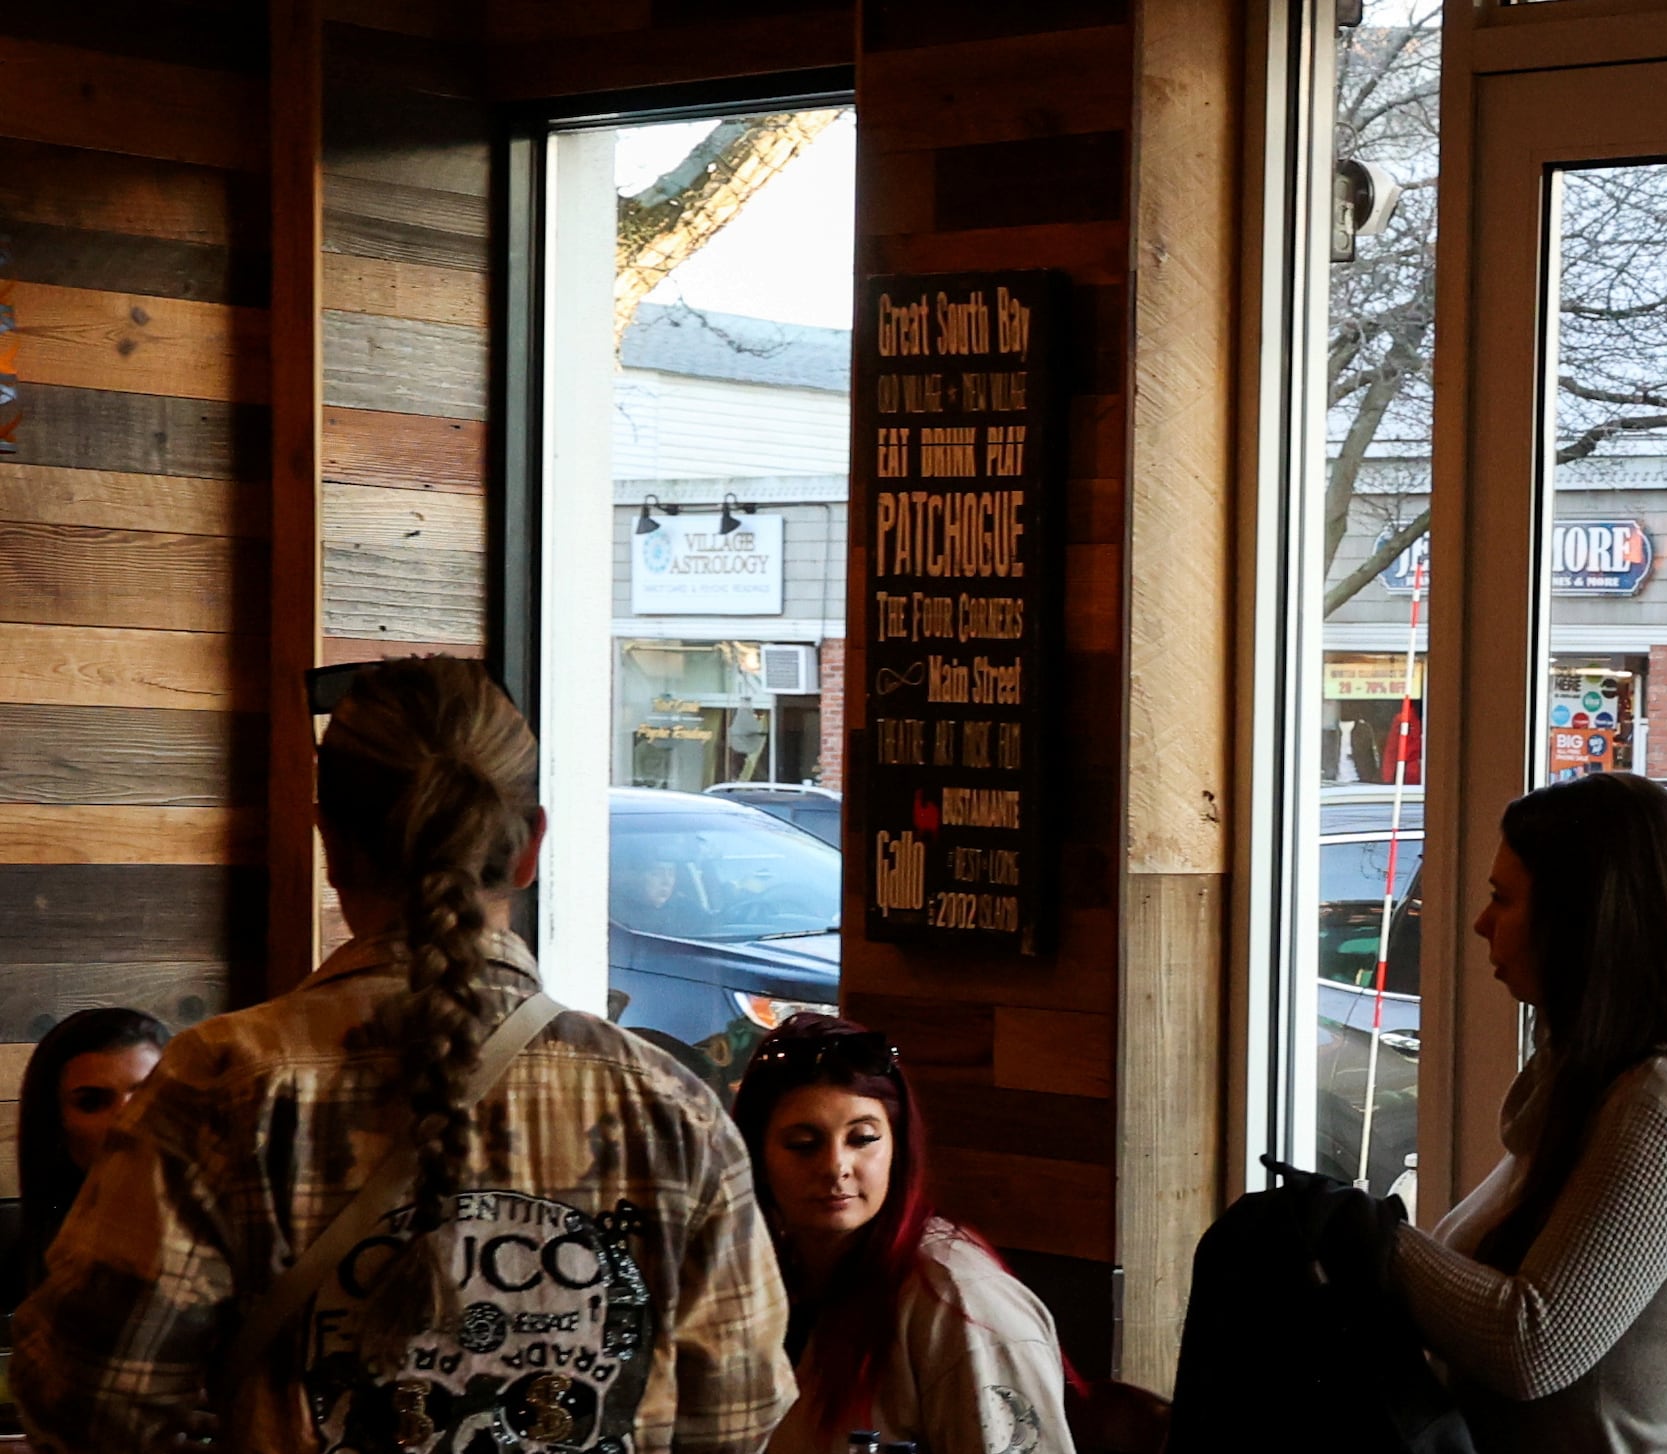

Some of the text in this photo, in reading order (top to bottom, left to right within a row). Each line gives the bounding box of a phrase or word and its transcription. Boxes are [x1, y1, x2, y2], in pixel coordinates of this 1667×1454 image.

[879, 286, 1031, 364] Great South Bay
[878, 425, 1026, 478] EAT DRINK PLAY
[684, 532, 756, 552] VILLAGE
[876, 490, 1025, 577] PATCHOGUE
[669, 555, 770, 575] ASTROLOGY
[876, 591, 1024, 644] THE FOUR CORNERS
[928, 655, 1021, 704] Main Street
[1556, 734, 1584, 749] BIG
[876, 830, 925, 918] Gallo
